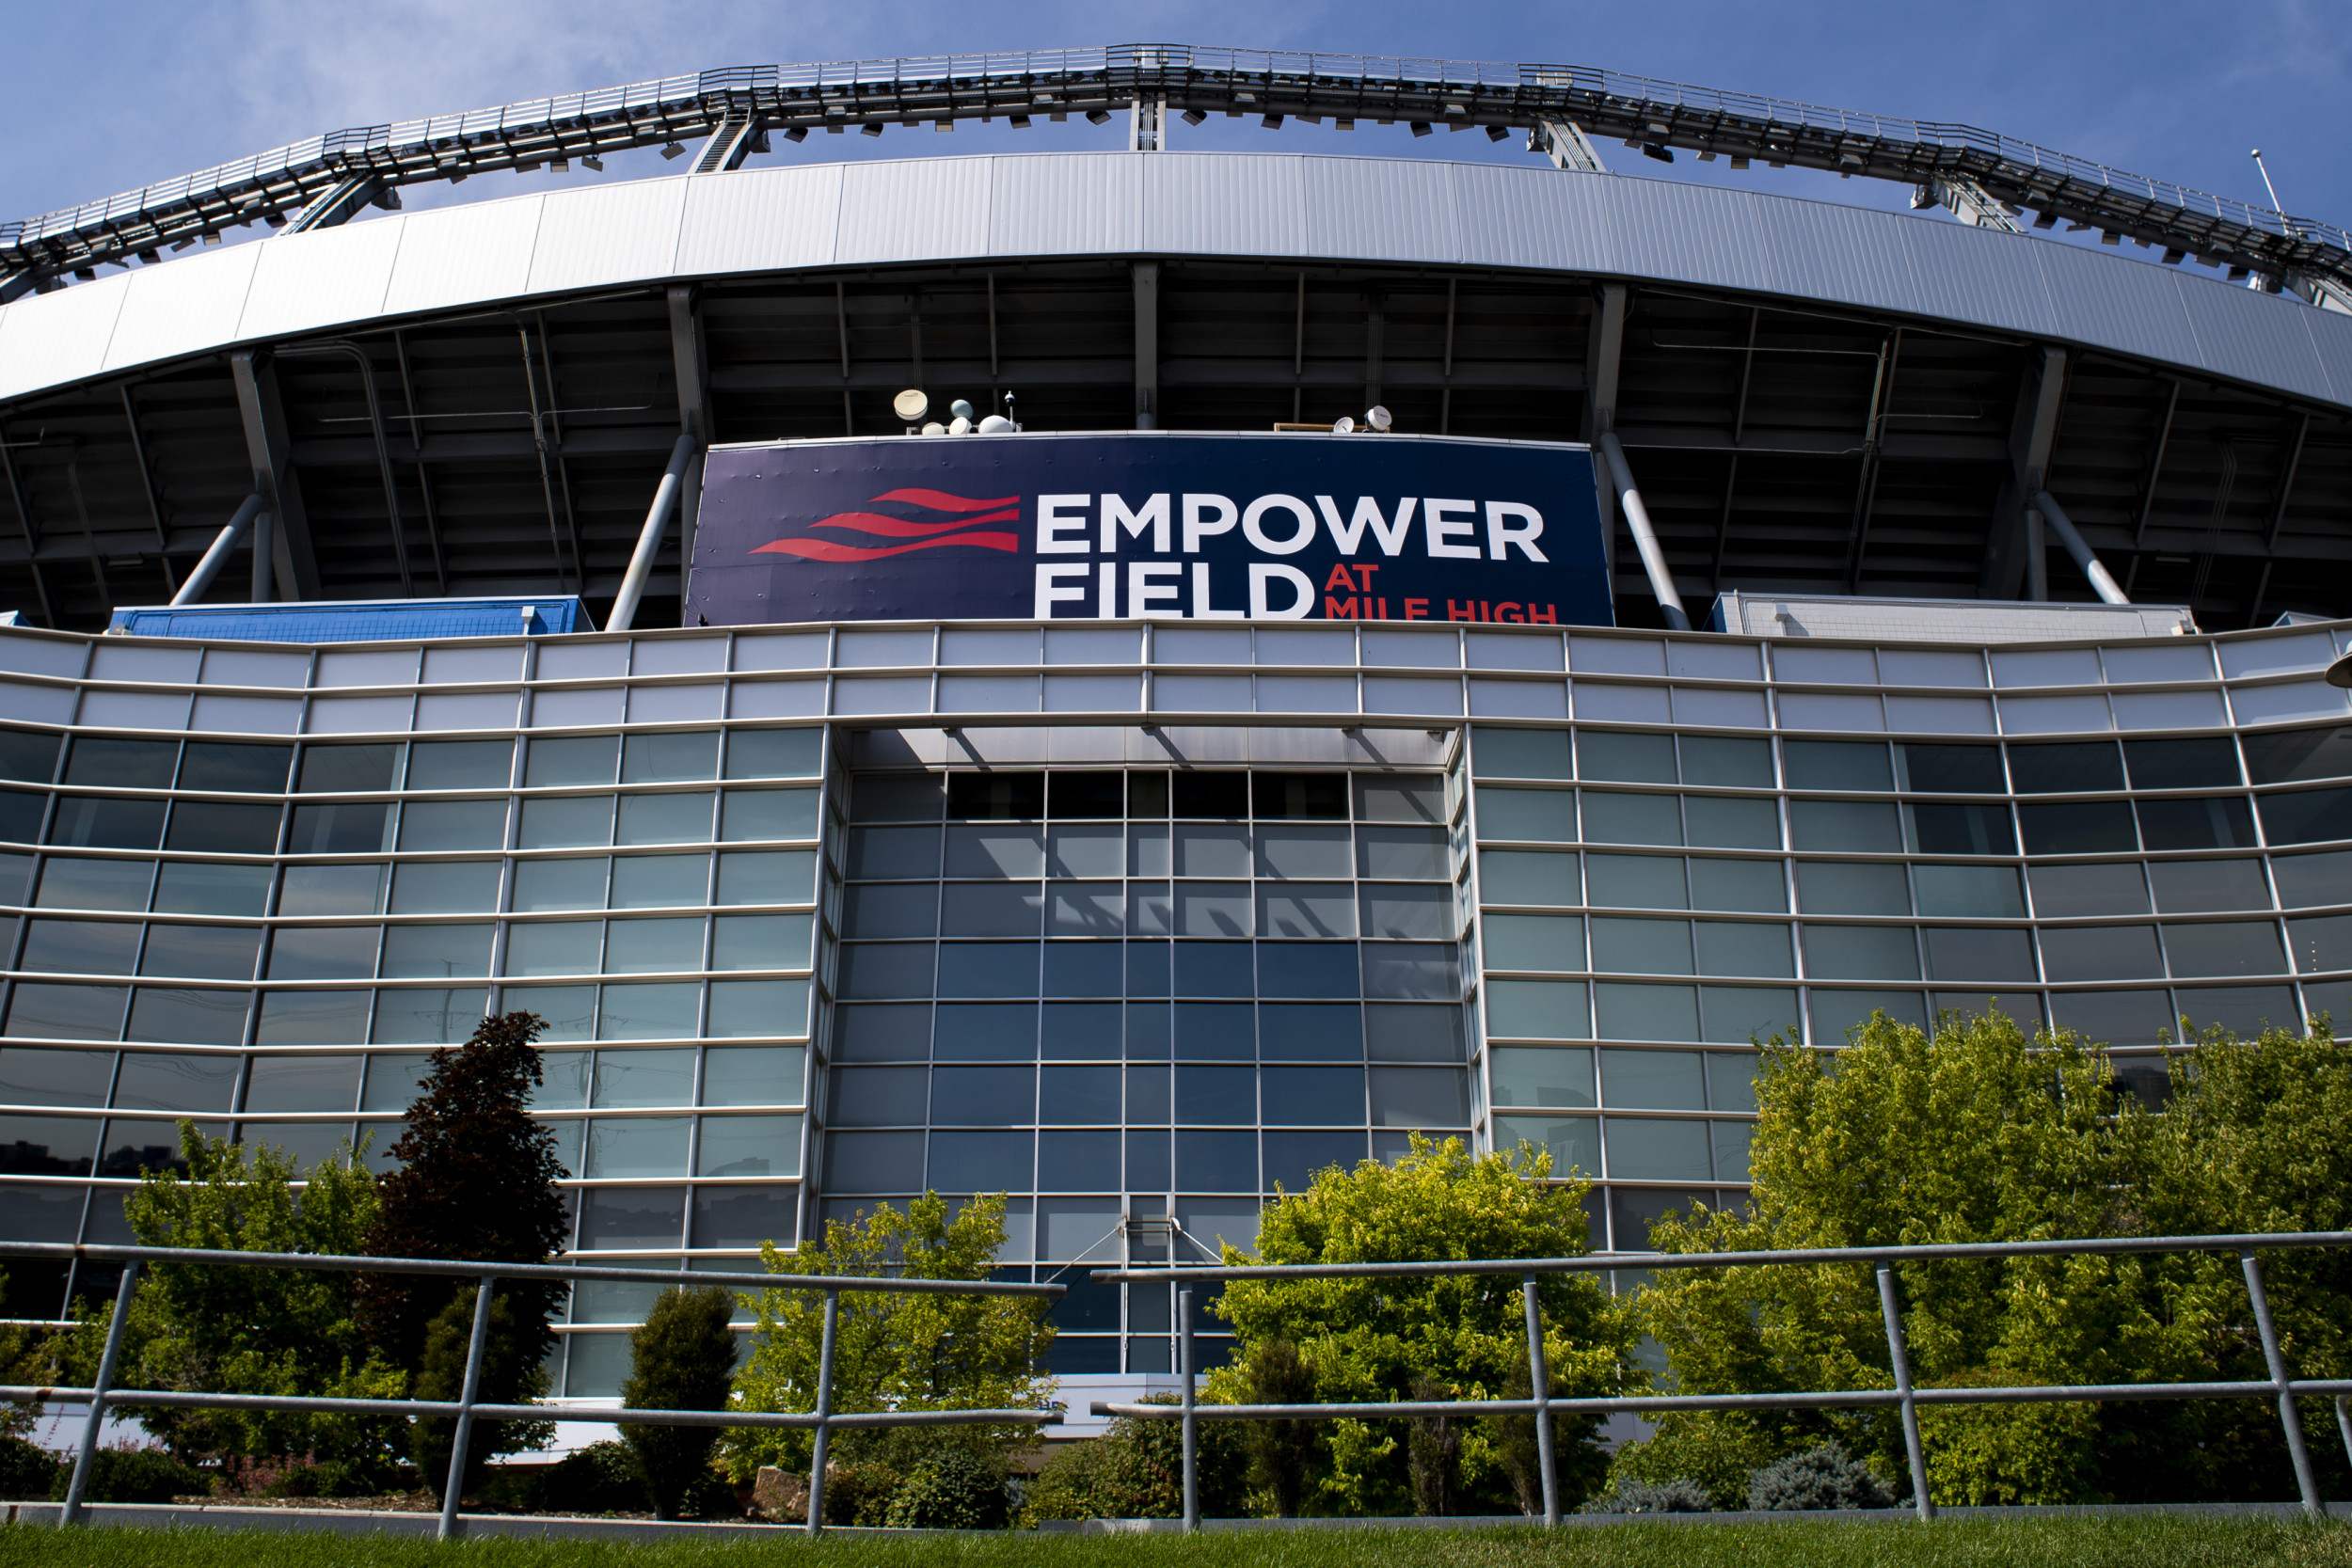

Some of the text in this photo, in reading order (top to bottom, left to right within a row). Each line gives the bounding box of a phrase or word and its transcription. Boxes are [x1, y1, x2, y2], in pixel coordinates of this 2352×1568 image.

[1036, 493, 1549, 562] EMPOWER
[1035, 562, 1315, 619] FIELD
[1324, 563, 1379, 592] AT
[1447, 599, 1557, 625] HIGH
